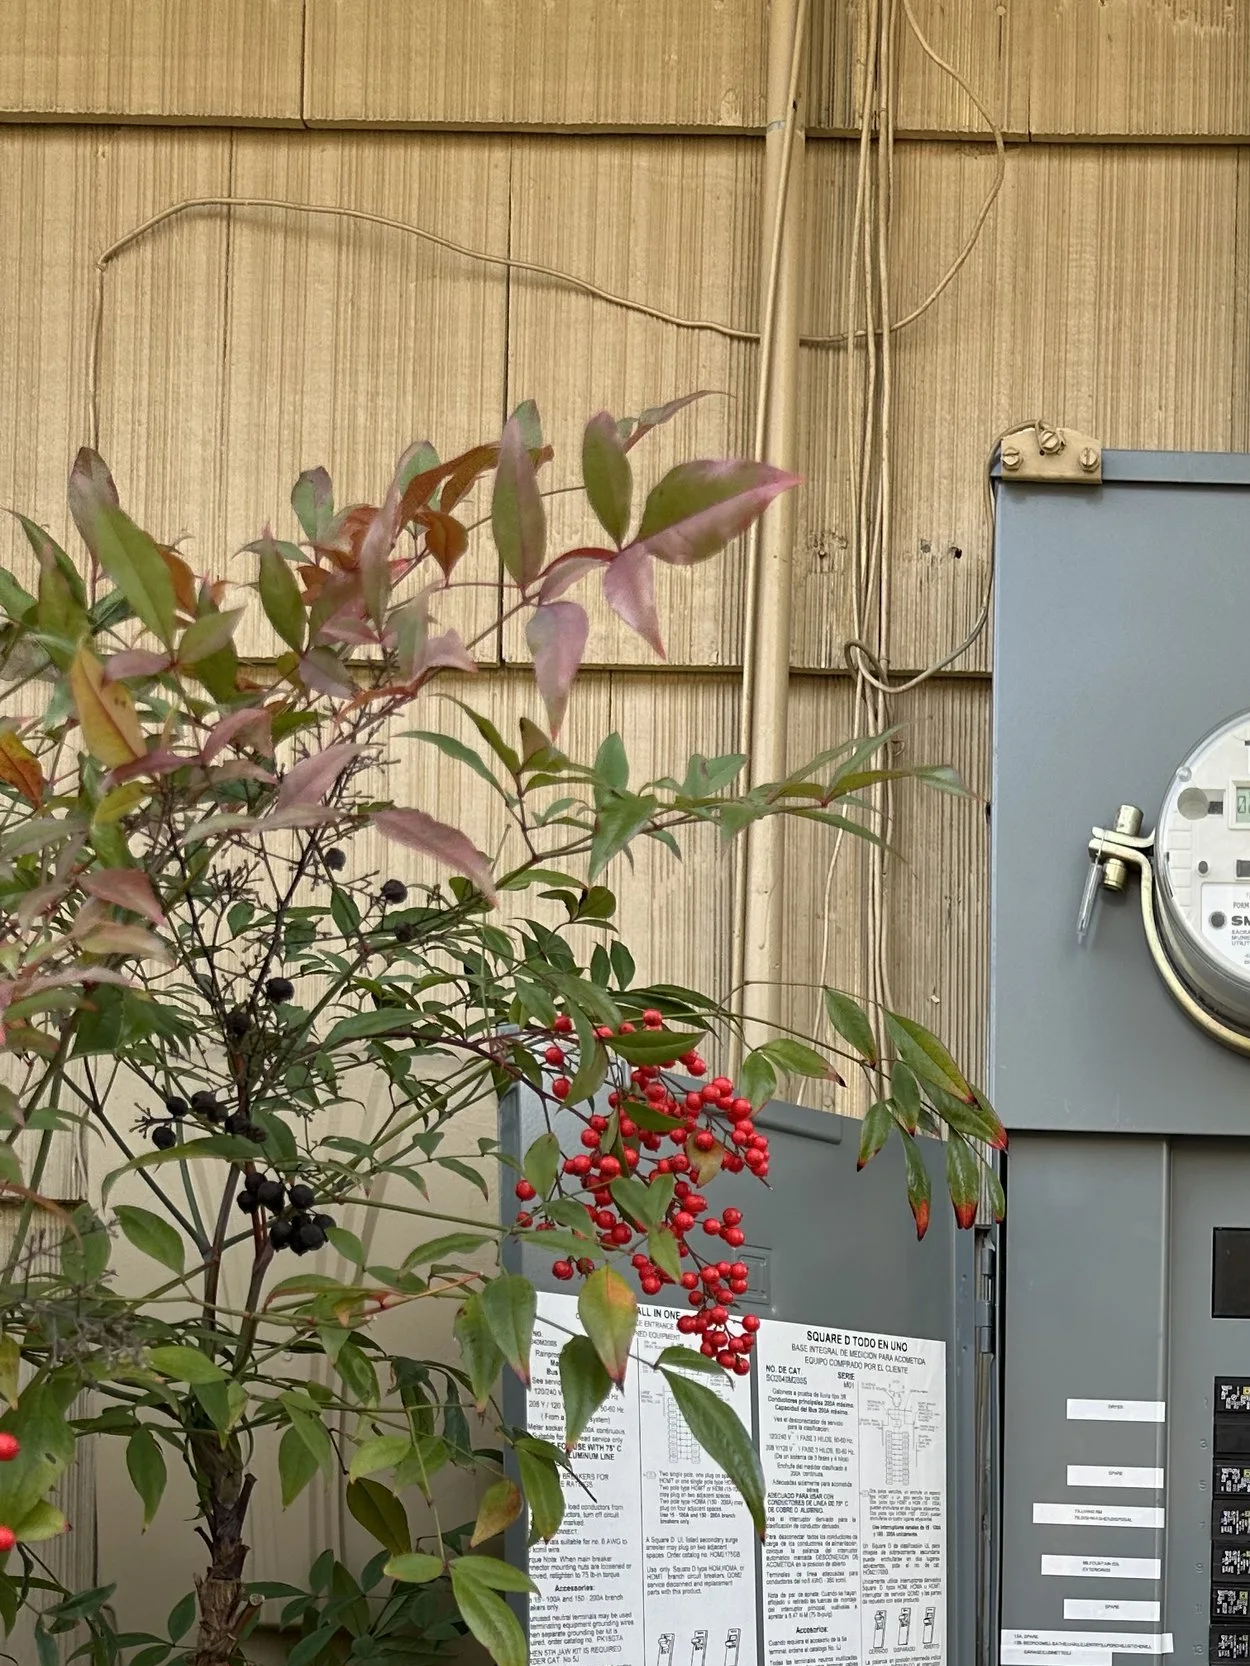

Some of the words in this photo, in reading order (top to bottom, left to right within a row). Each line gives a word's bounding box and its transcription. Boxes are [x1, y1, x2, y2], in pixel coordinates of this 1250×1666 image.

[653, 1308, 662, 1319] IN
[663, 1309, 681, 1320] ONE
[644, 1320, 674, 1330] ENTRANCE
[648, 1331, 681, 1340] EQUIPMENT
[806, 1331, 843, 1344] SQUARE
[844, 1335, 850, 1345] D
[852, 1336, 876, 1348] TODO
[878, 1339, 889, 1350] EN
[890, 1340, 908, 1352] UNO
[791, 1343, 808, 1353] BASE
[809, 1345, 839, 1356] INTEGRAL
[840, 1348, 848, 1357] DE
[878, 1352, 893, 1362] PARA
[894, 1355, 926, 1365] ACOMETIDA
[778, 1366, 788, 1374] DE
[804, 1356, 828, 1366] EQUIPO
[829, 1358, 863, 1369] COMPRADO
[864, 1362, 876, 1371] POR
[877, 1363, 884, 1372] EL
[885, 1364, 909, 1374] CLIENTE
[837, 1372, 855, 1380] SERIE
[600, 1453, 615, 1461] LINE
